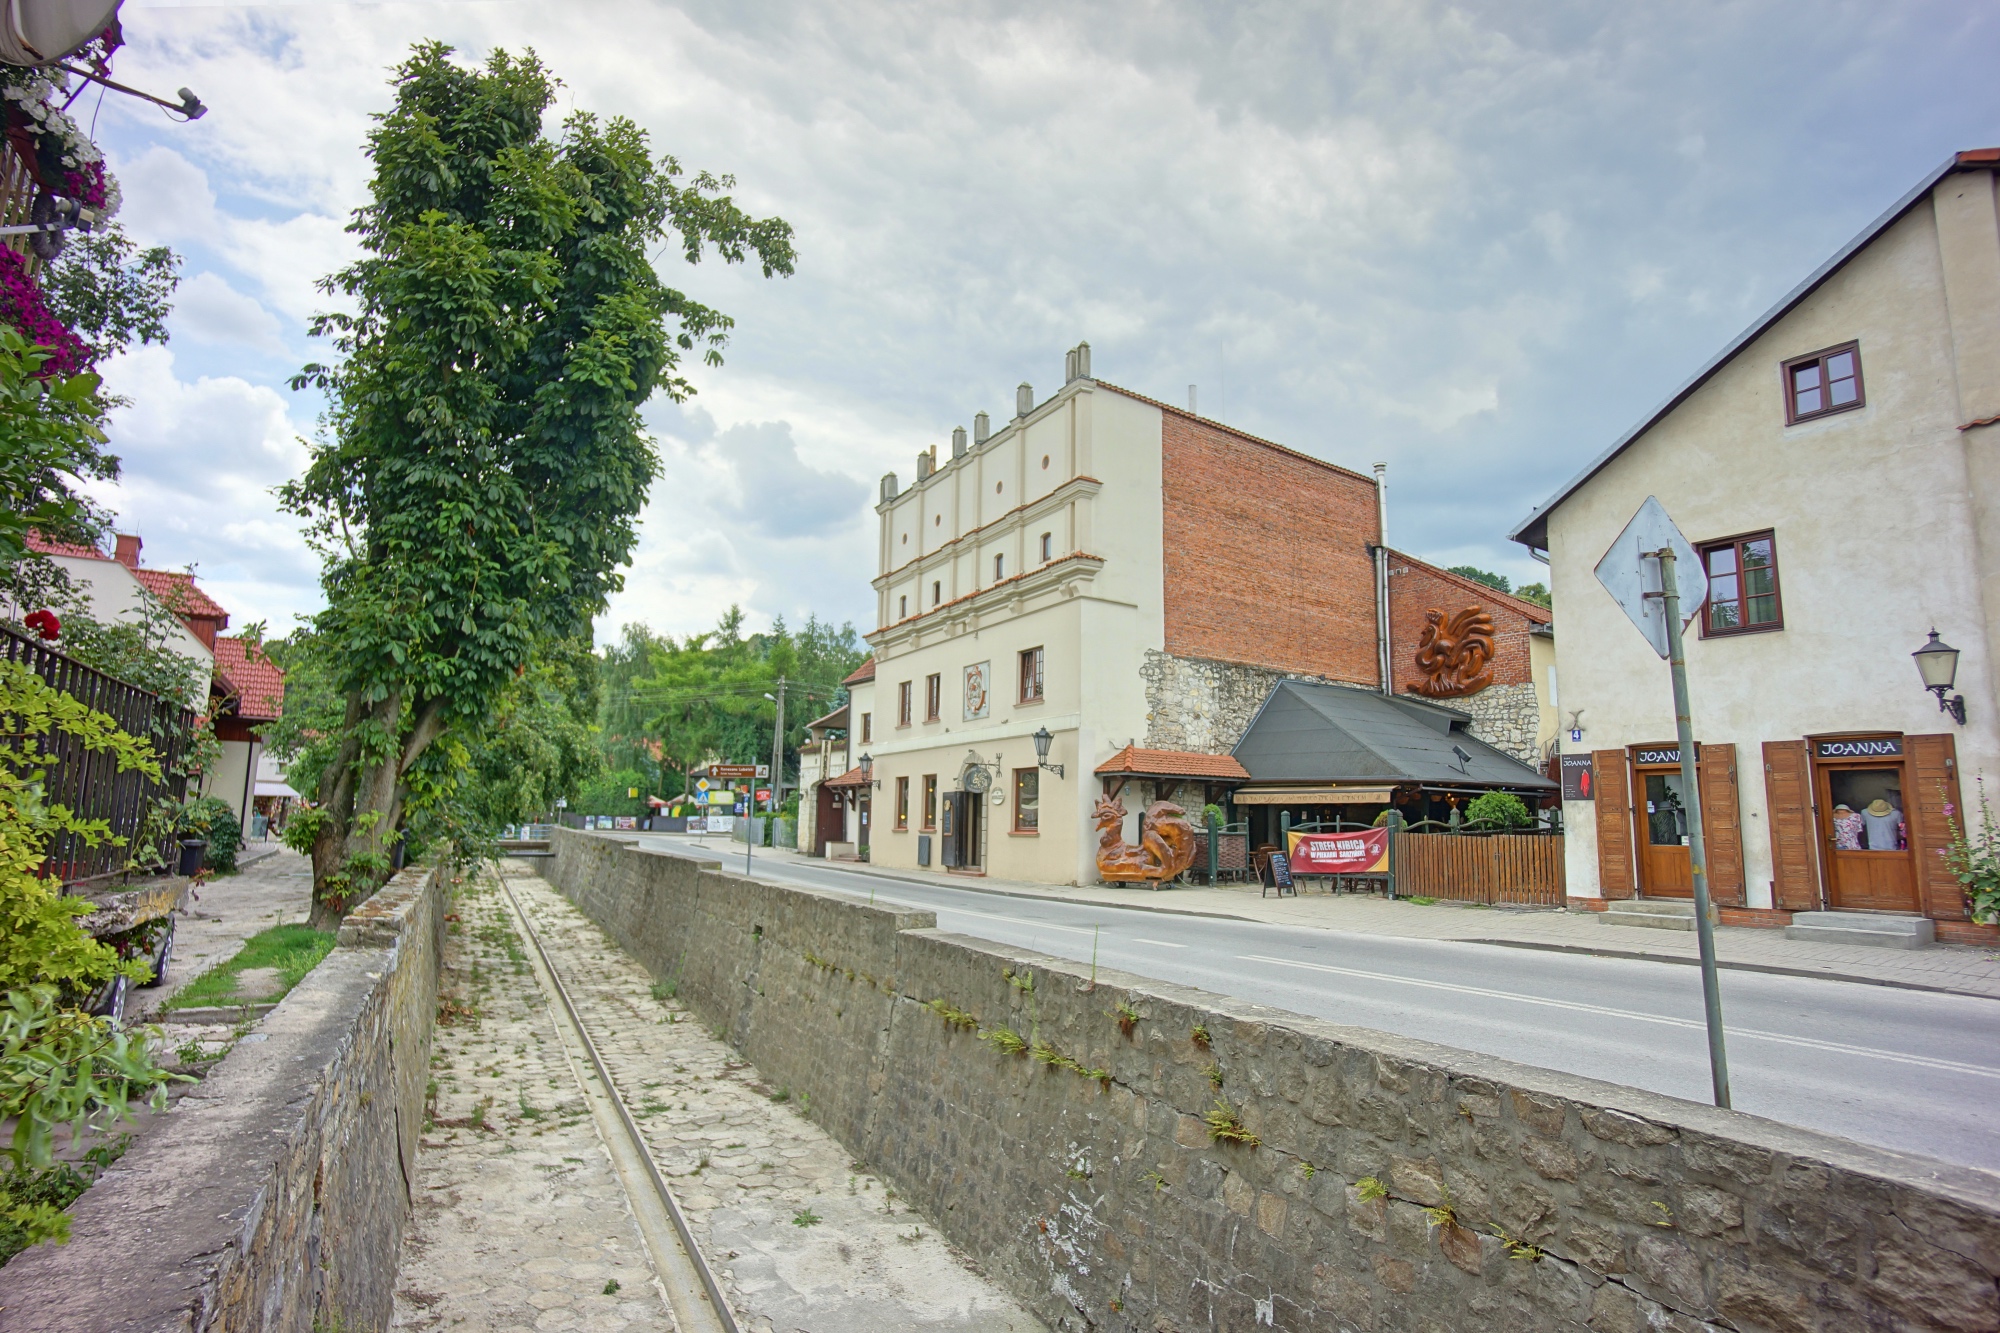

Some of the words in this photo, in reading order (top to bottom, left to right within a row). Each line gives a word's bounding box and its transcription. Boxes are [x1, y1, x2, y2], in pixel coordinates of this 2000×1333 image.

[1573, 731, 1579, 739] 4
[1821, 741, 1897, 755] JOANNA
[1640, 751, 1696, 762] JOAN
[1310, 841, 1337, 851] STREFA
[1336, 839, 1365, 850] KIBICA
